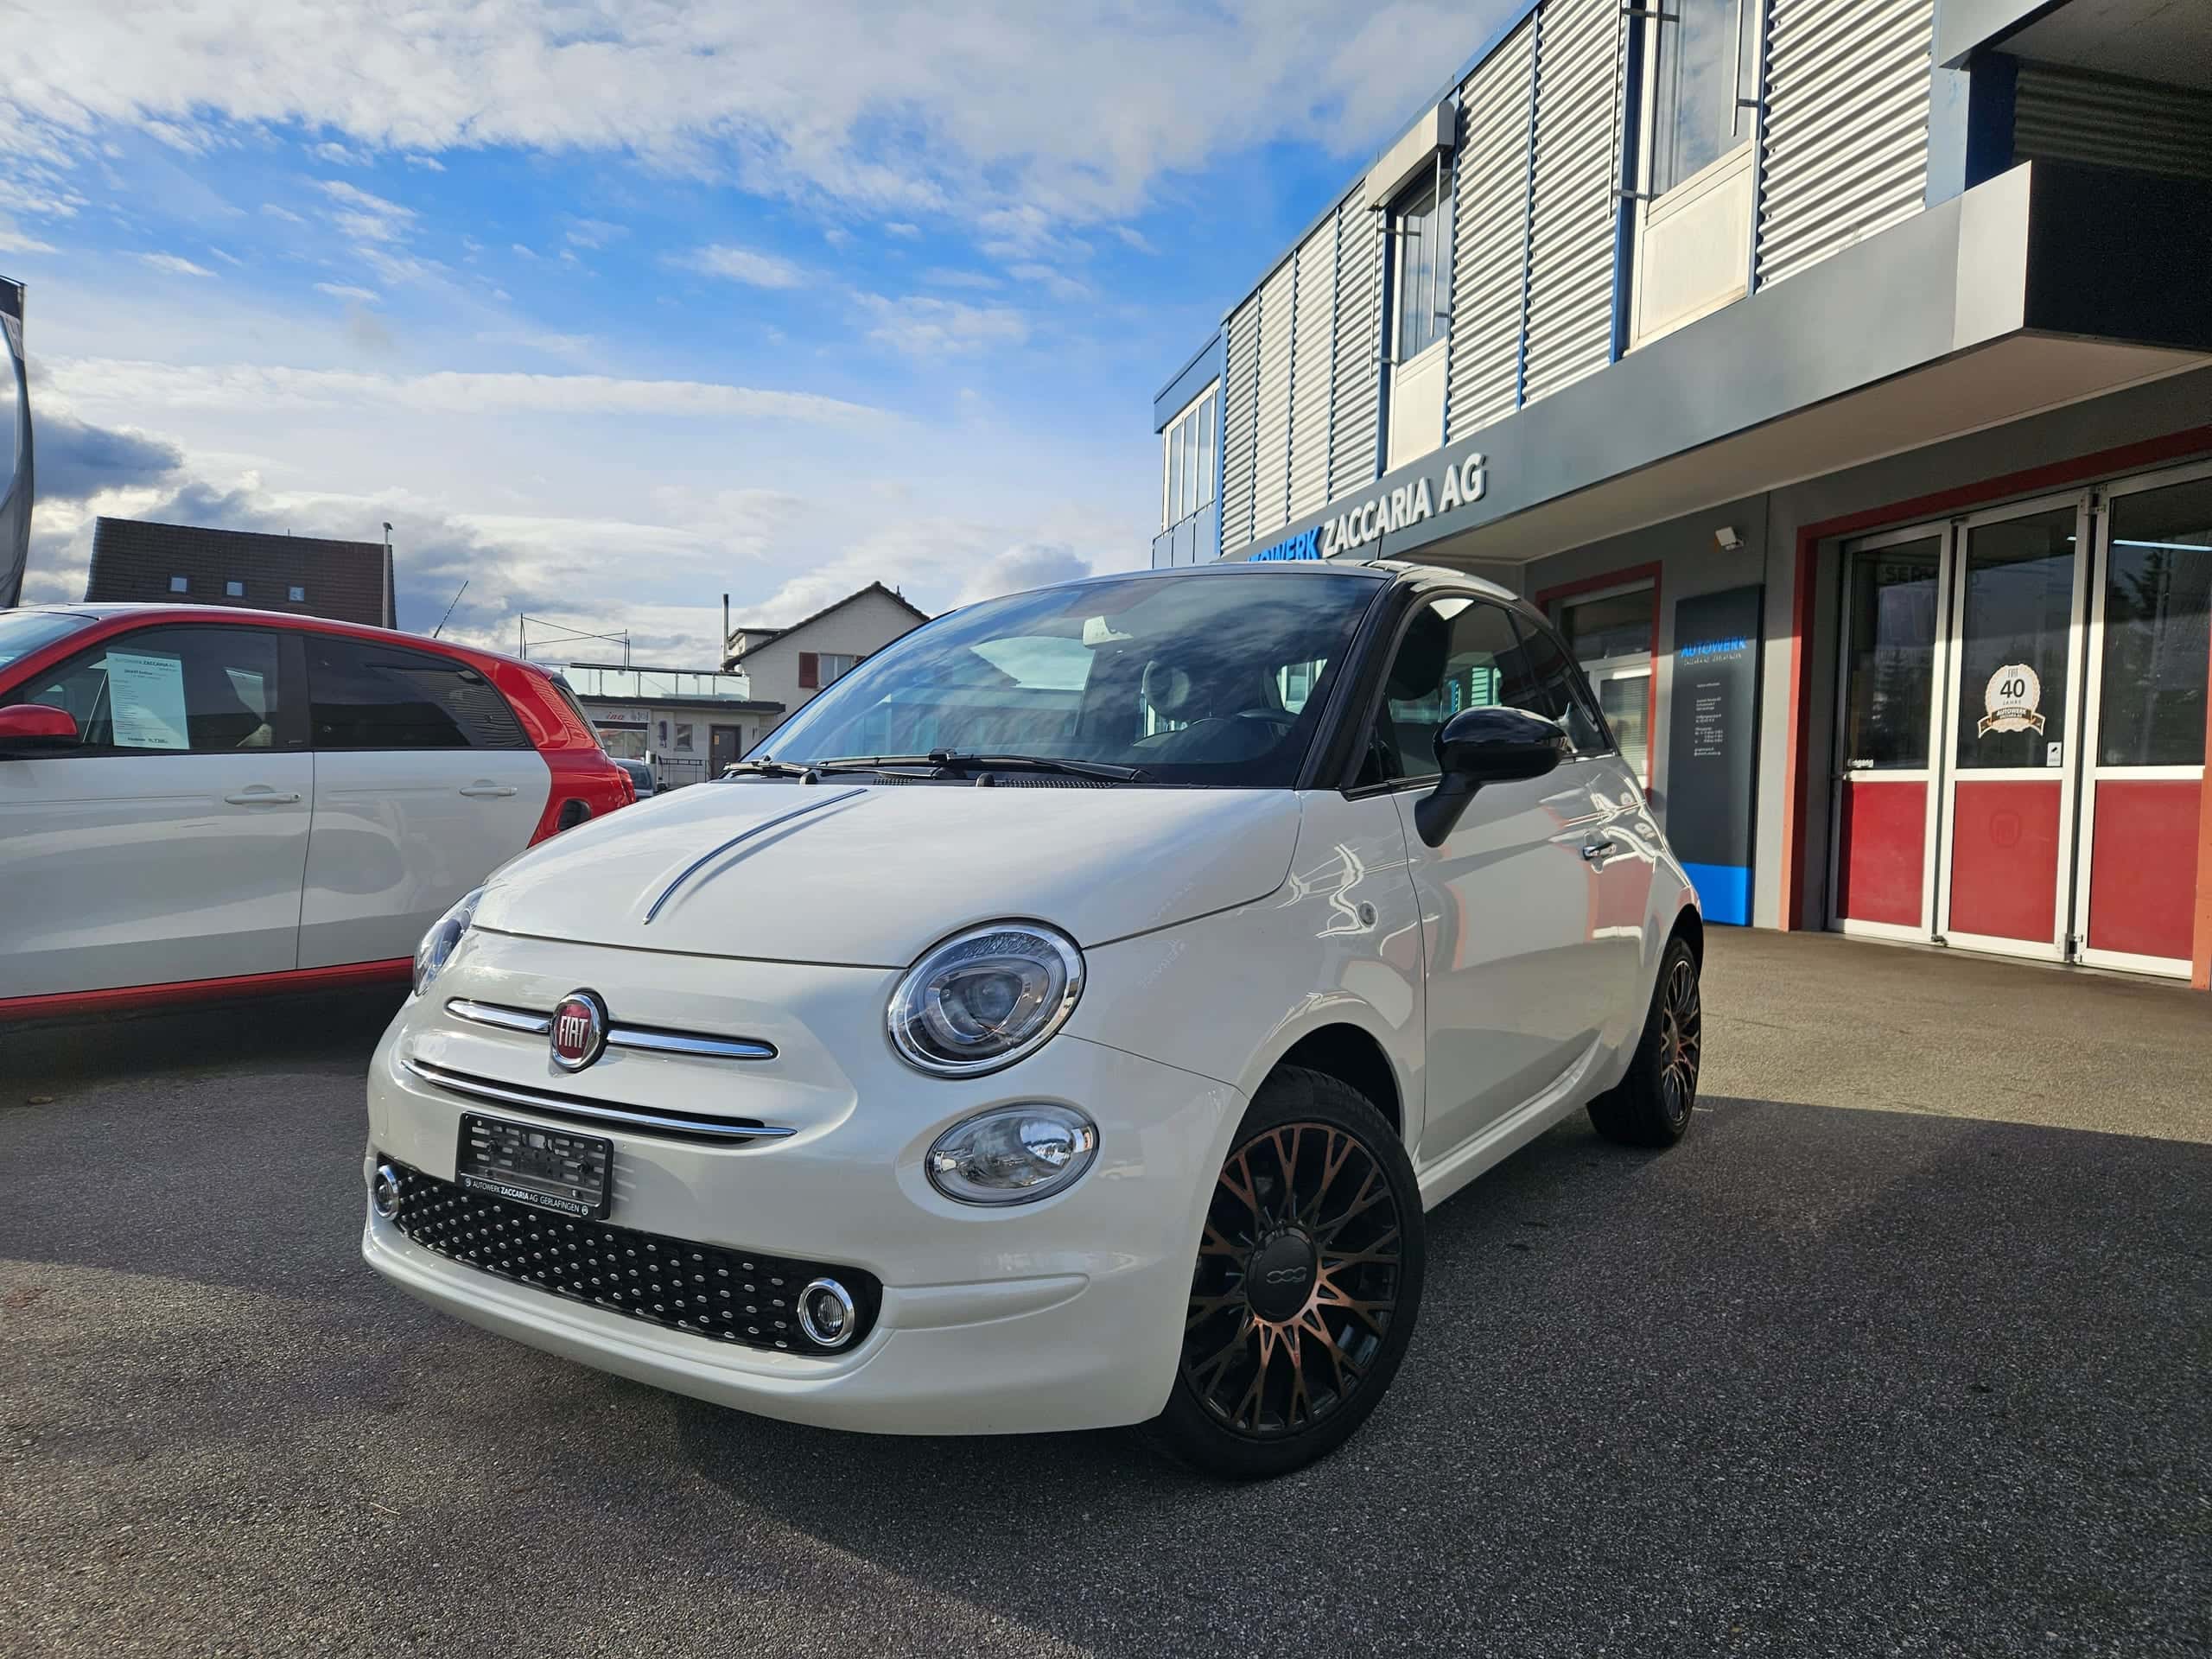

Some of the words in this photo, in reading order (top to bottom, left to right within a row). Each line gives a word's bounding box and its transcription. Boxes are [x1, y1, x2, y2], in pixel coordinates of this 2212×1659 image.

[1322, 477, 1435, 558] ZACCARIA
[1439, 453, 1486, 512] AG
[1680, 636, 1746, 657] AUTOWERK
[1999, 679, 2025, 698] 40
[558, 1015, 588, 1049] FIAT
[473, 1179, 500, 1193] AUTOWERK
[500, 1186, 529, 1201] ZACCARIA
[528, 1193, 538, 1203] AG
[540, 1196, 580, 1213] GERLAFINGEN
